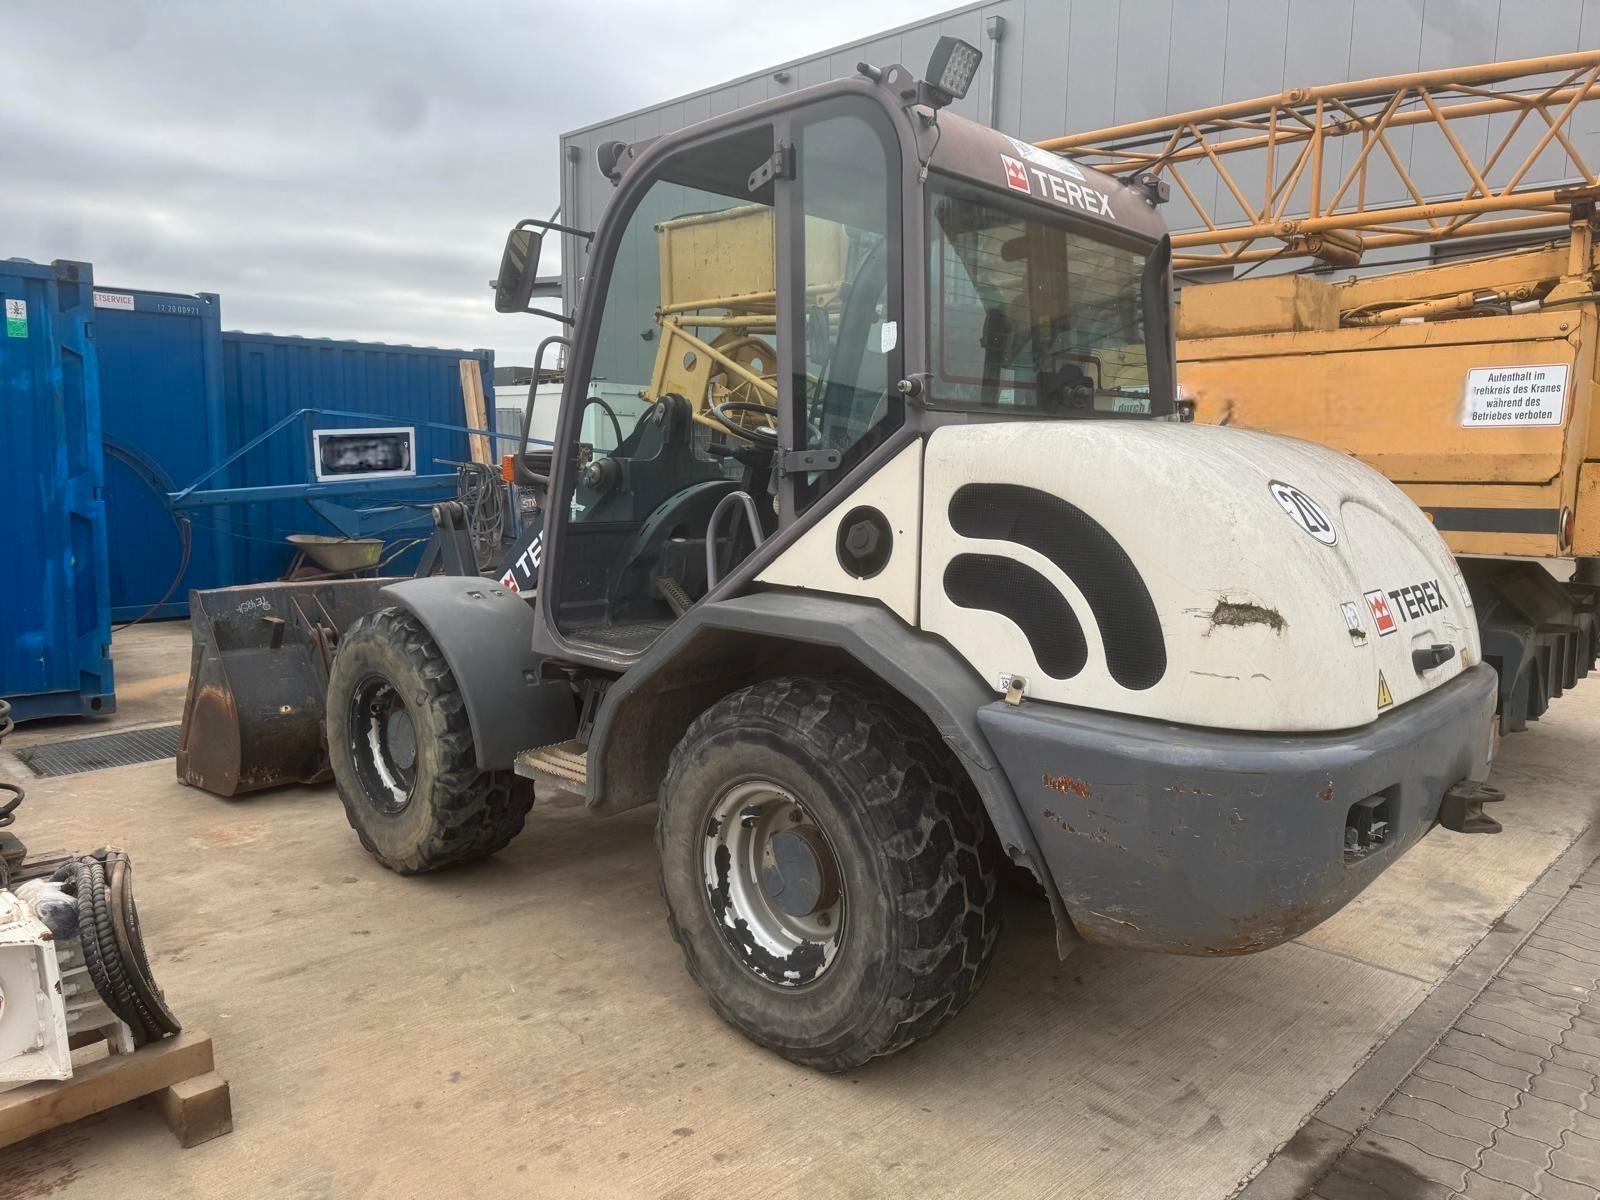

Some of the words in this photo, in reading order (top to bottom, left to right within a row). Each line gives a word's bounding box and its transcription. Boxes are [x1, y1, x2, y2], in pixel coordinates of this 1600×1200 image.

[1030, 167, 1116, 220] TEREX
[1488, 371, 1532, 383] Aufenthalt
[1534, 371, 1546, 380] im
[1513, 384, 1529, 394] des
[1531, 383, 1562, 393] Kranes
[1472, 411, 1512, 421] Betriebes
[1514, 409, 1553, 420] verboten
[1486, 397, 1523, 408] während
[1525, 397, 1541, 407] des
[1278, 490, 1331, 533] 20
[515, 529, 544, 579] TE
[1387, 578, 1449, 623] TEREX
